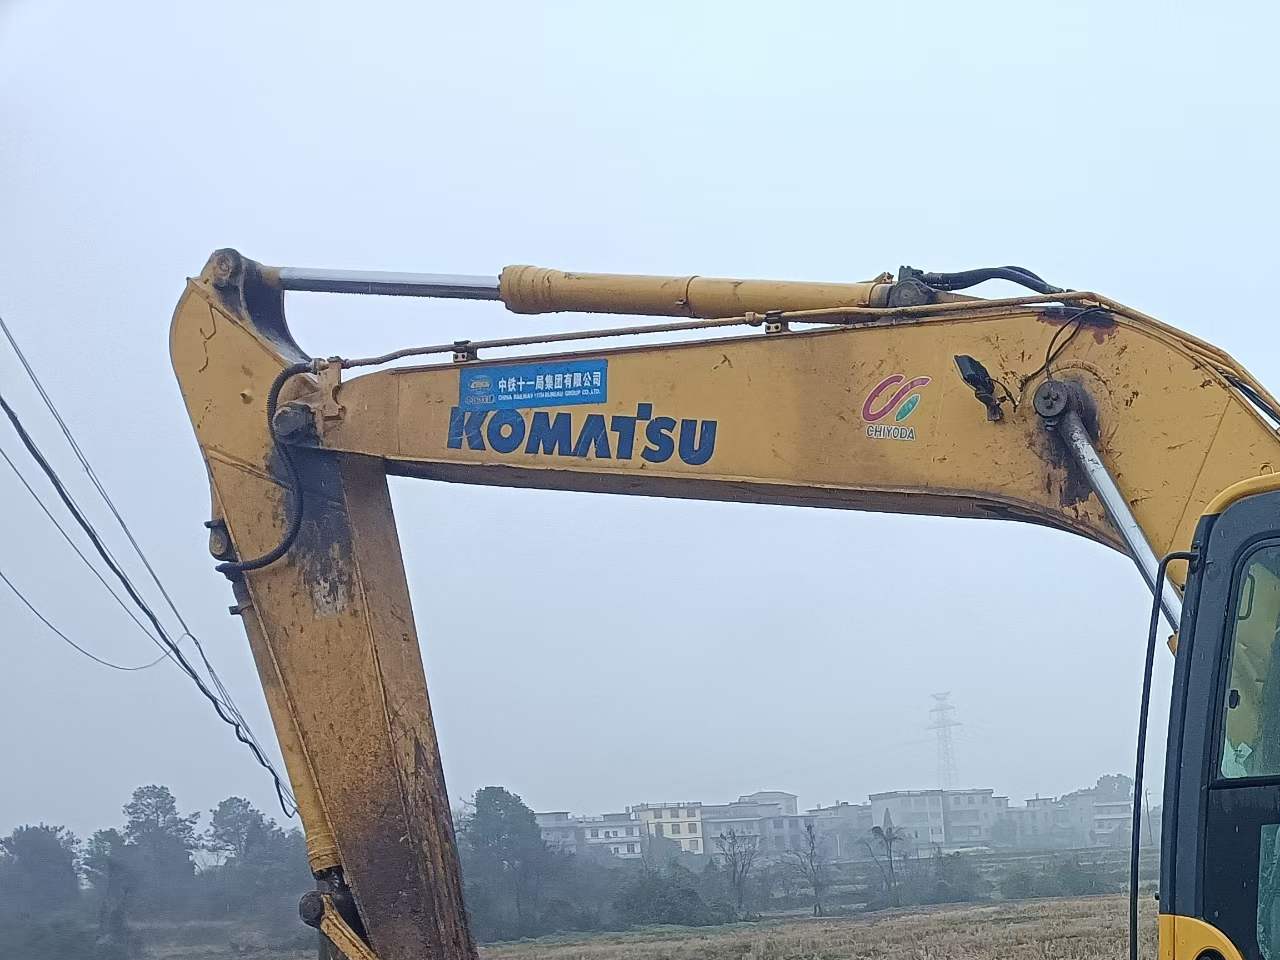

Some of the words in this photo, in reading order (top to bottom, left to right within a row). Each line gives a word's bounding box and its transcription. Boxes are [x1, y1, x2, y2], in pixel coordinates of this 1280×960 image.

[498, 371, 601, 393] 中铁十一局集团有限公司
[447, 403, 718, 466] KOMATSU
[866, 425, 915, 440] CHIYODA
